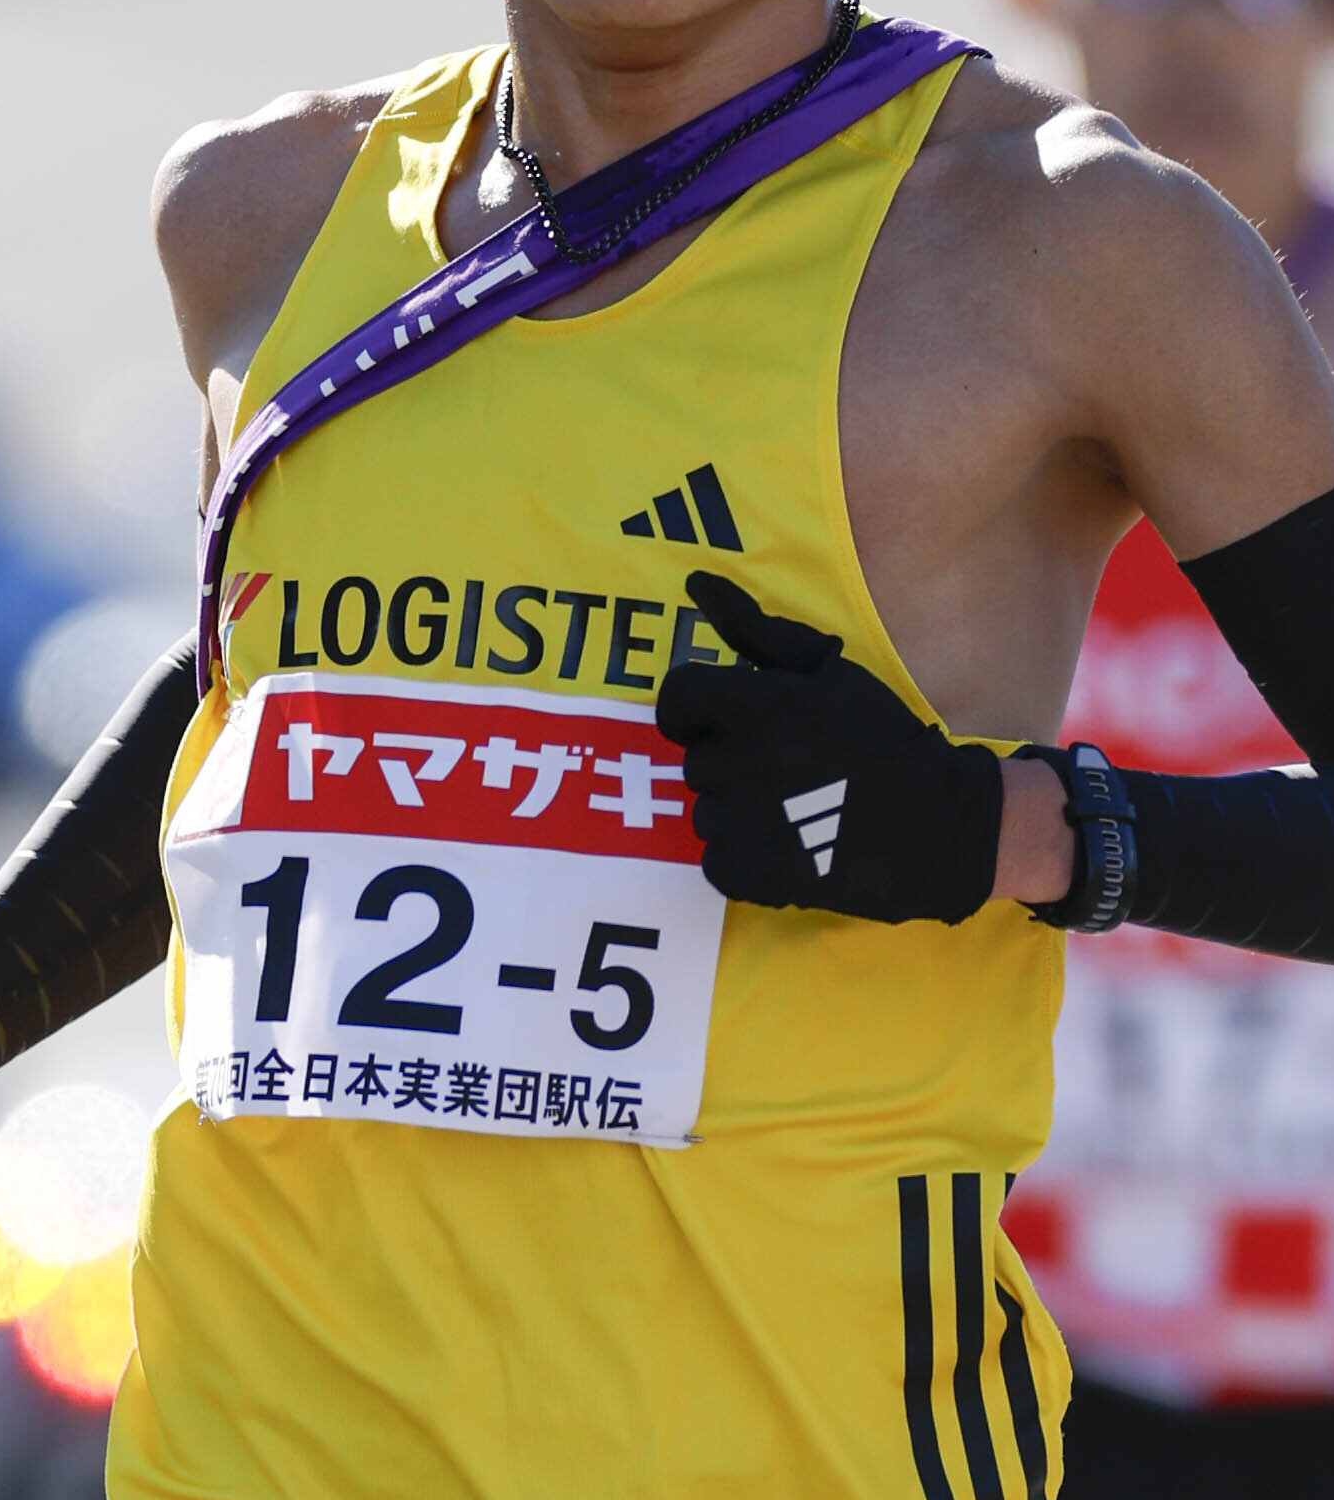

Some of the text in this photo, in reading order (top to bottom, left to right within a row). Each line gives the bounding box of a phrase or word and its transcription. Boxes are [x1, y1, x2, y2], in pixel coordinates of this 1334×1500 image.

[278, 575, 749, 690] LOGISTEE
[277, 722, 685, 828] ヤマザキ
[240, 855, 661, 1051] 12-5
